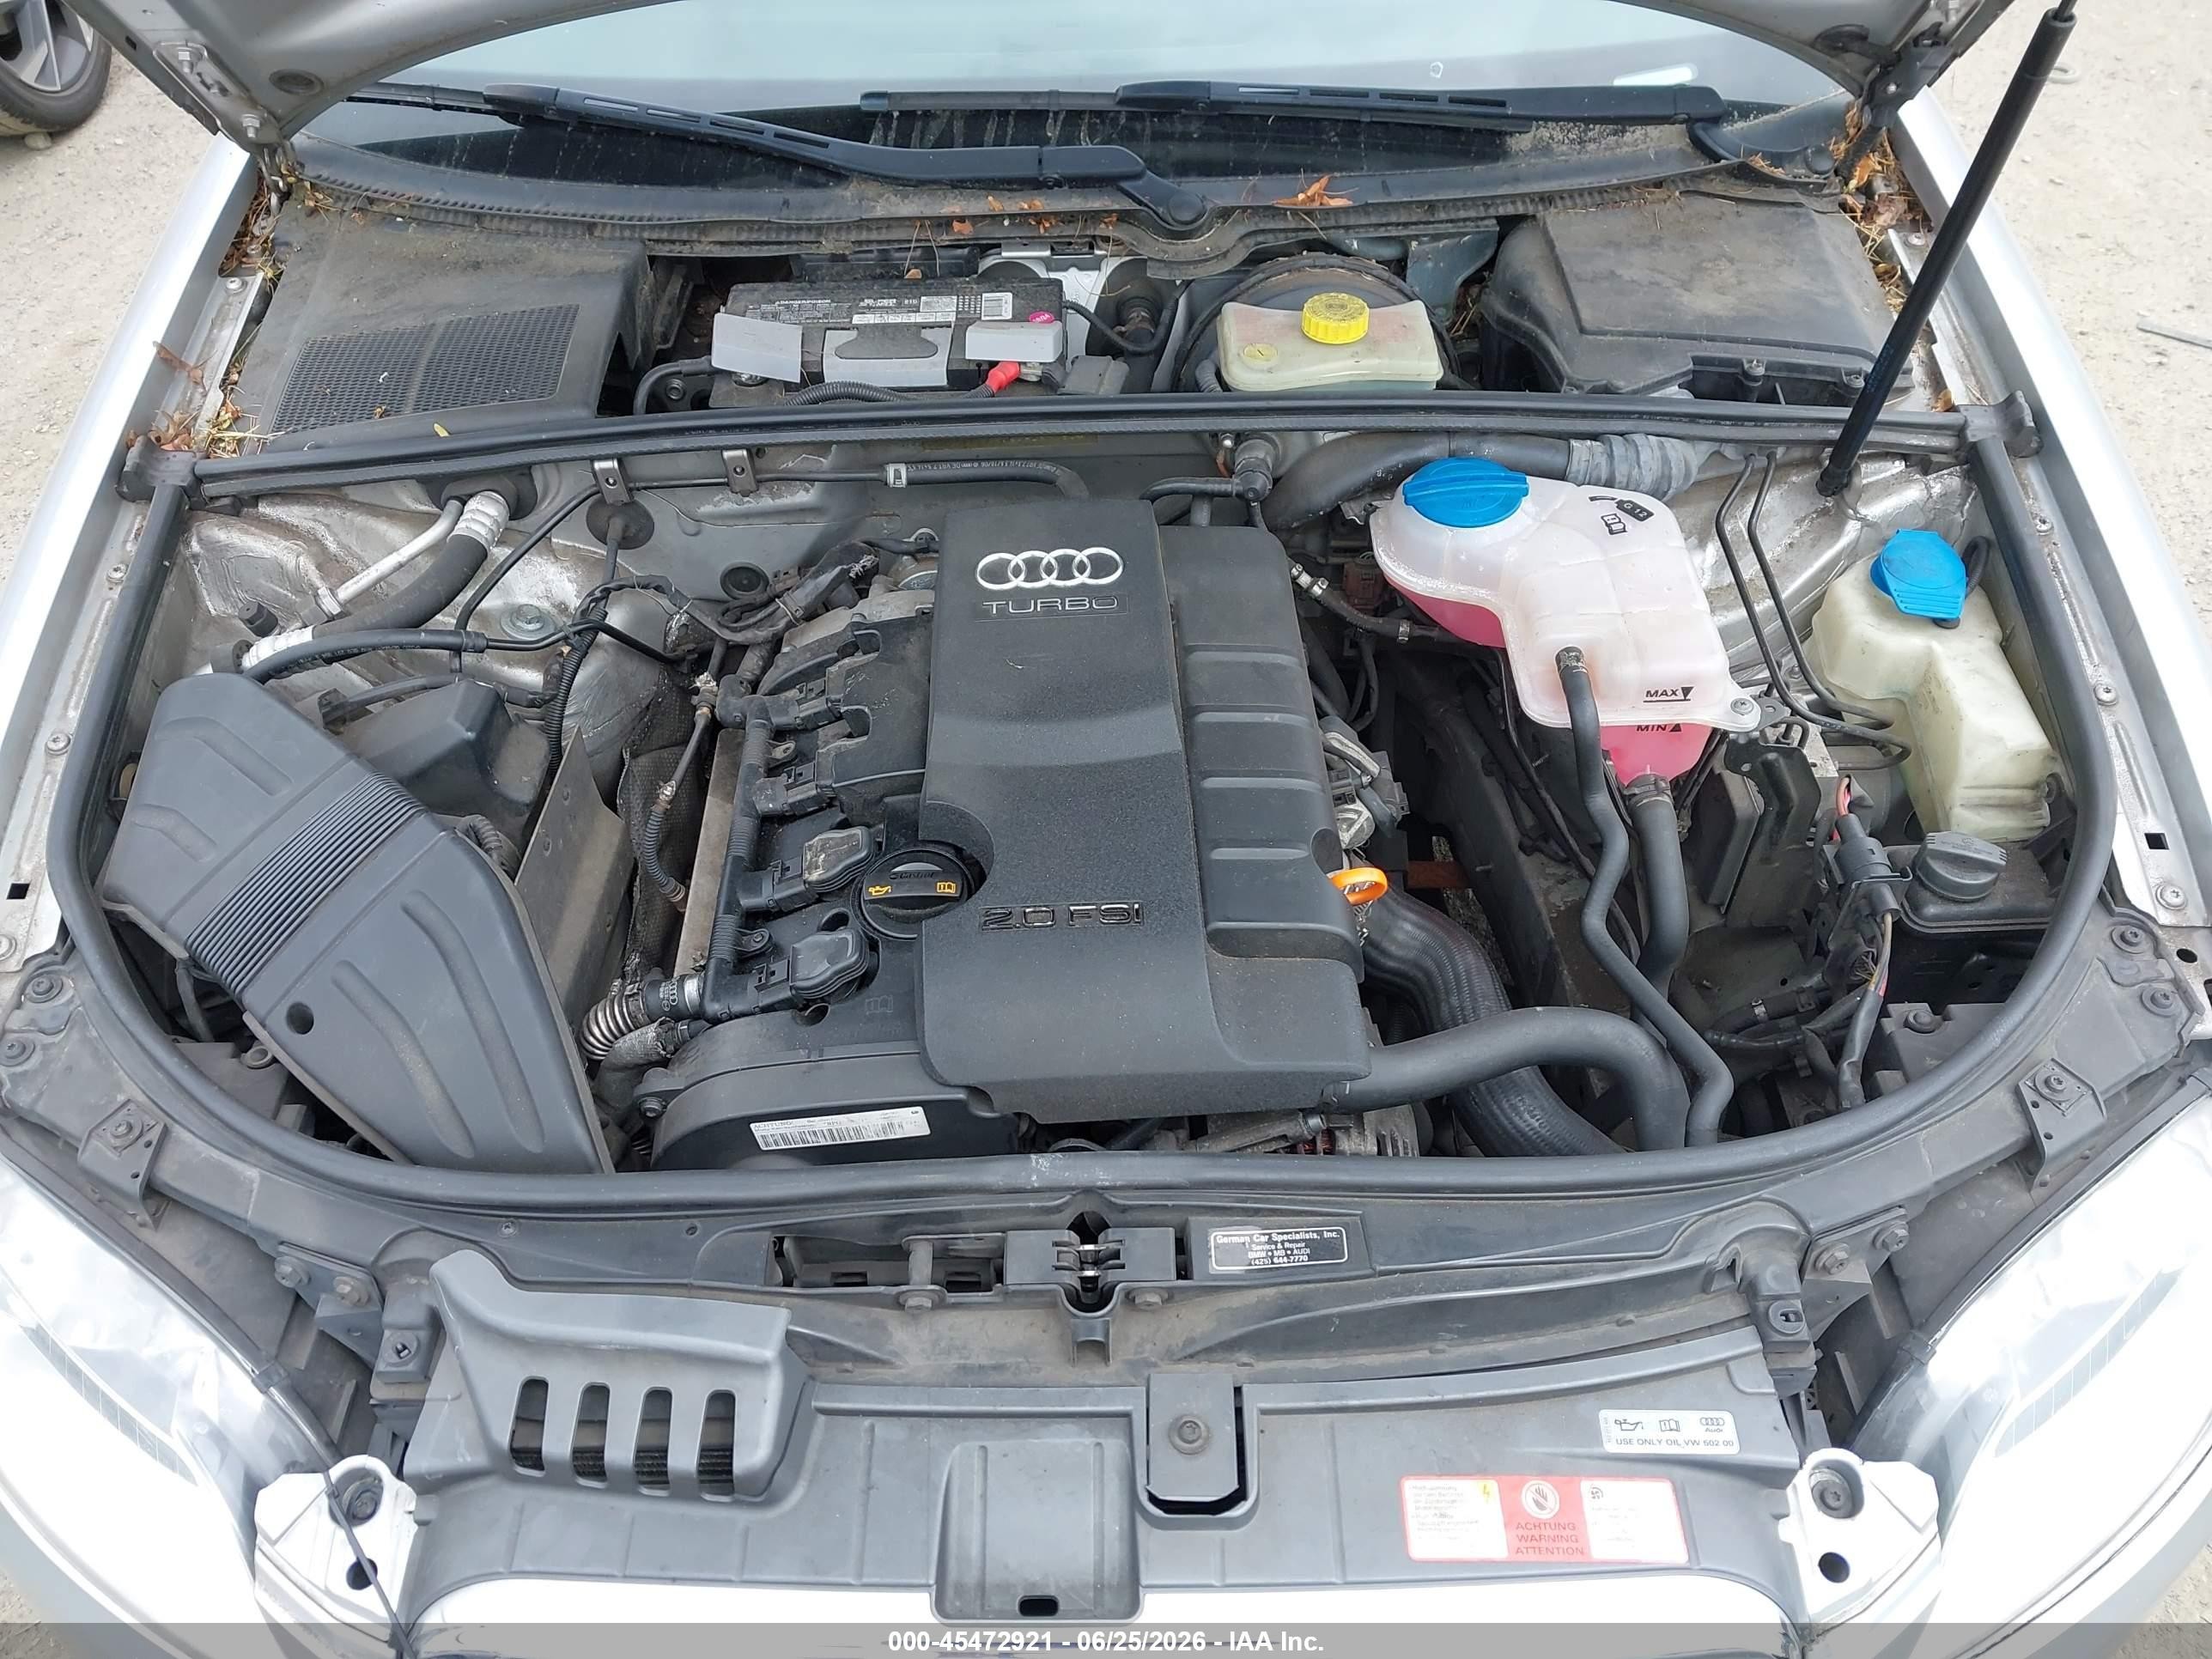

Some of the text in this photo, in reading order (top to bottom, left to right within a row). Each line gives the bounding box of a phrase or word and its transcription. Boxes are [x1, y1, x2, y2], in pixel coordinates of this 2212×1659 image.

[1623, 502, 1648, 519] G 12
[981, 595, 1118, 616] TURBO
[1645, 688, 1680, 699] MAX
[981, 902, 1145, 932] 2.0 FSI
[1253, 1234, 1269, 1243] Car
[1271, 1231, 1321, 1242] Specialists,
[1323, 1230, 1340, 1239] Inc.
[1293, 1248, 1310, 1256] AUDI
[1516, 1522, 1577, 1531] ACHTUNG
[1516, 1534, 1579, 1543] WARNING
[1515, 1546, 1585, 1556] ATTENTION
